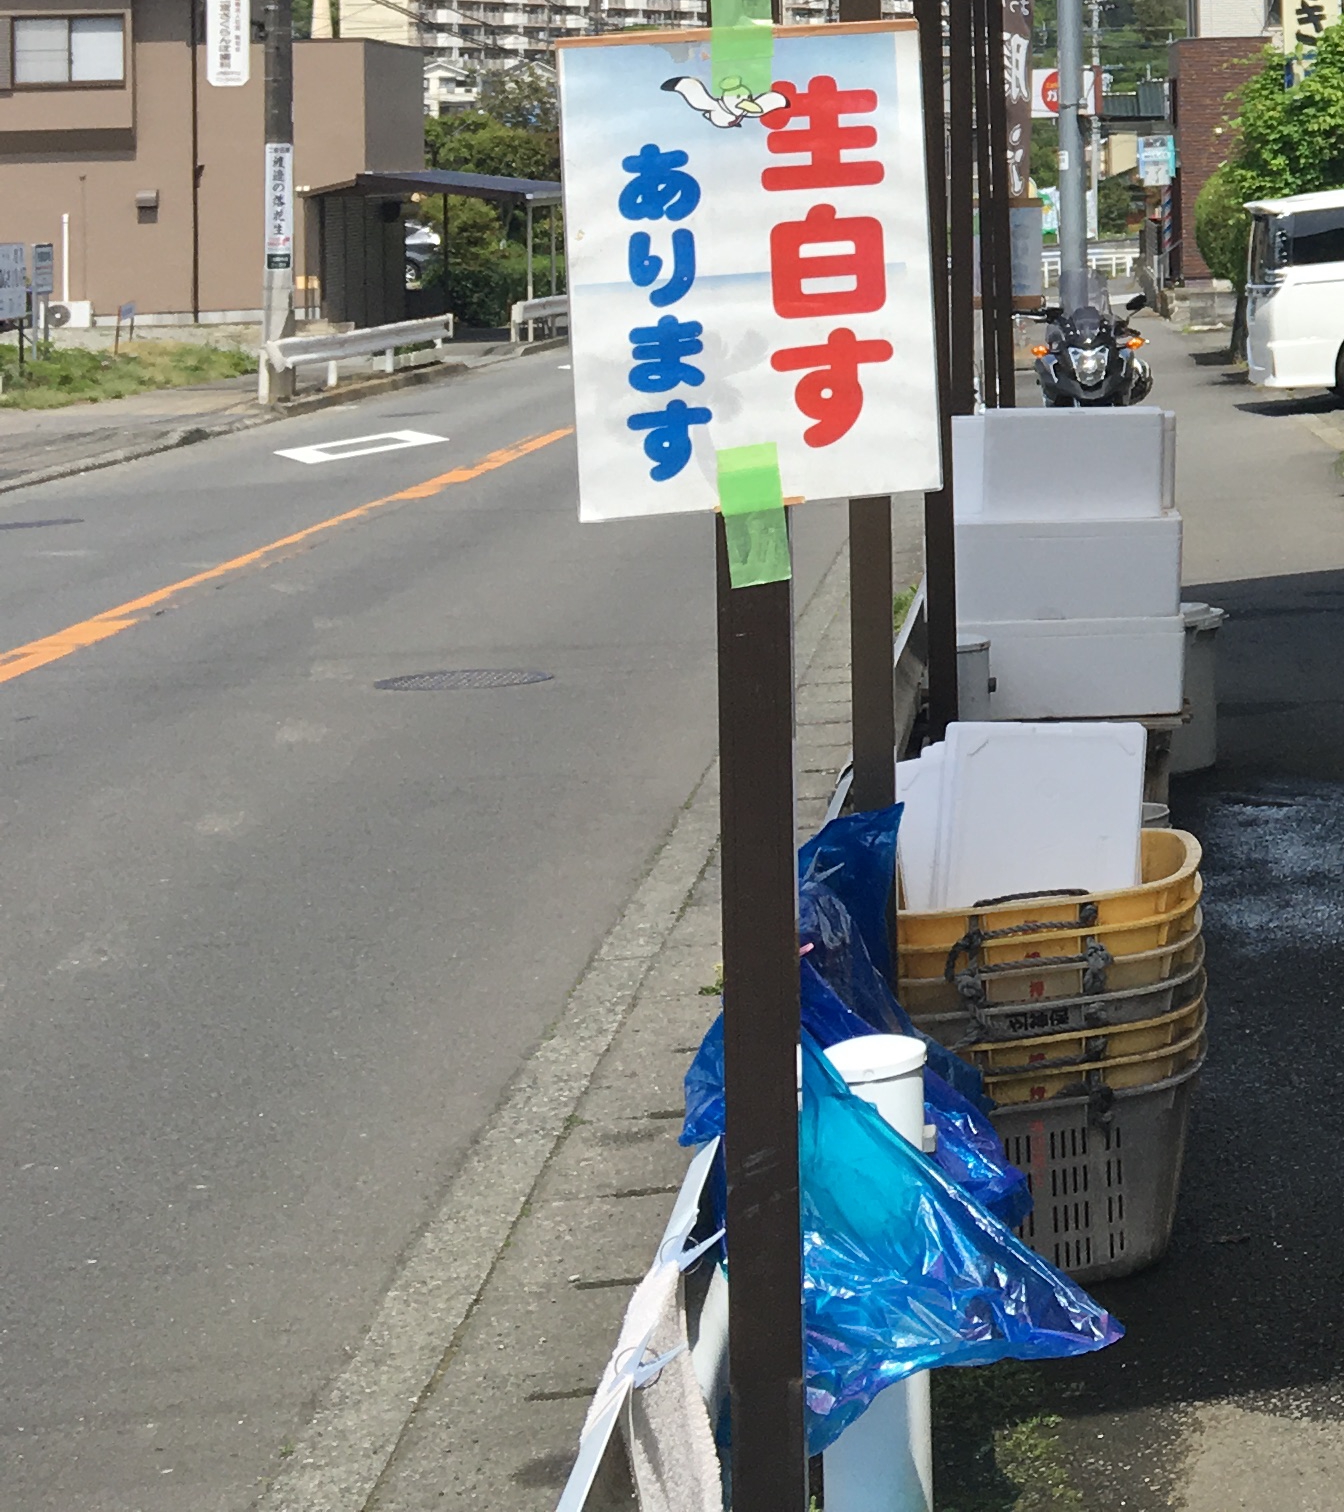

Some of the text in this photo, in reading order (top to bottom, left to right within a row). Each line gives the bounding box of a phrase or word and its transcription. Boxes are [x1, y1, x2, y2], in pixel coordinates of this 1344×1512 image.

[618, 143, 713, 482] あります
[760, 74, 894, 449] 生白す
